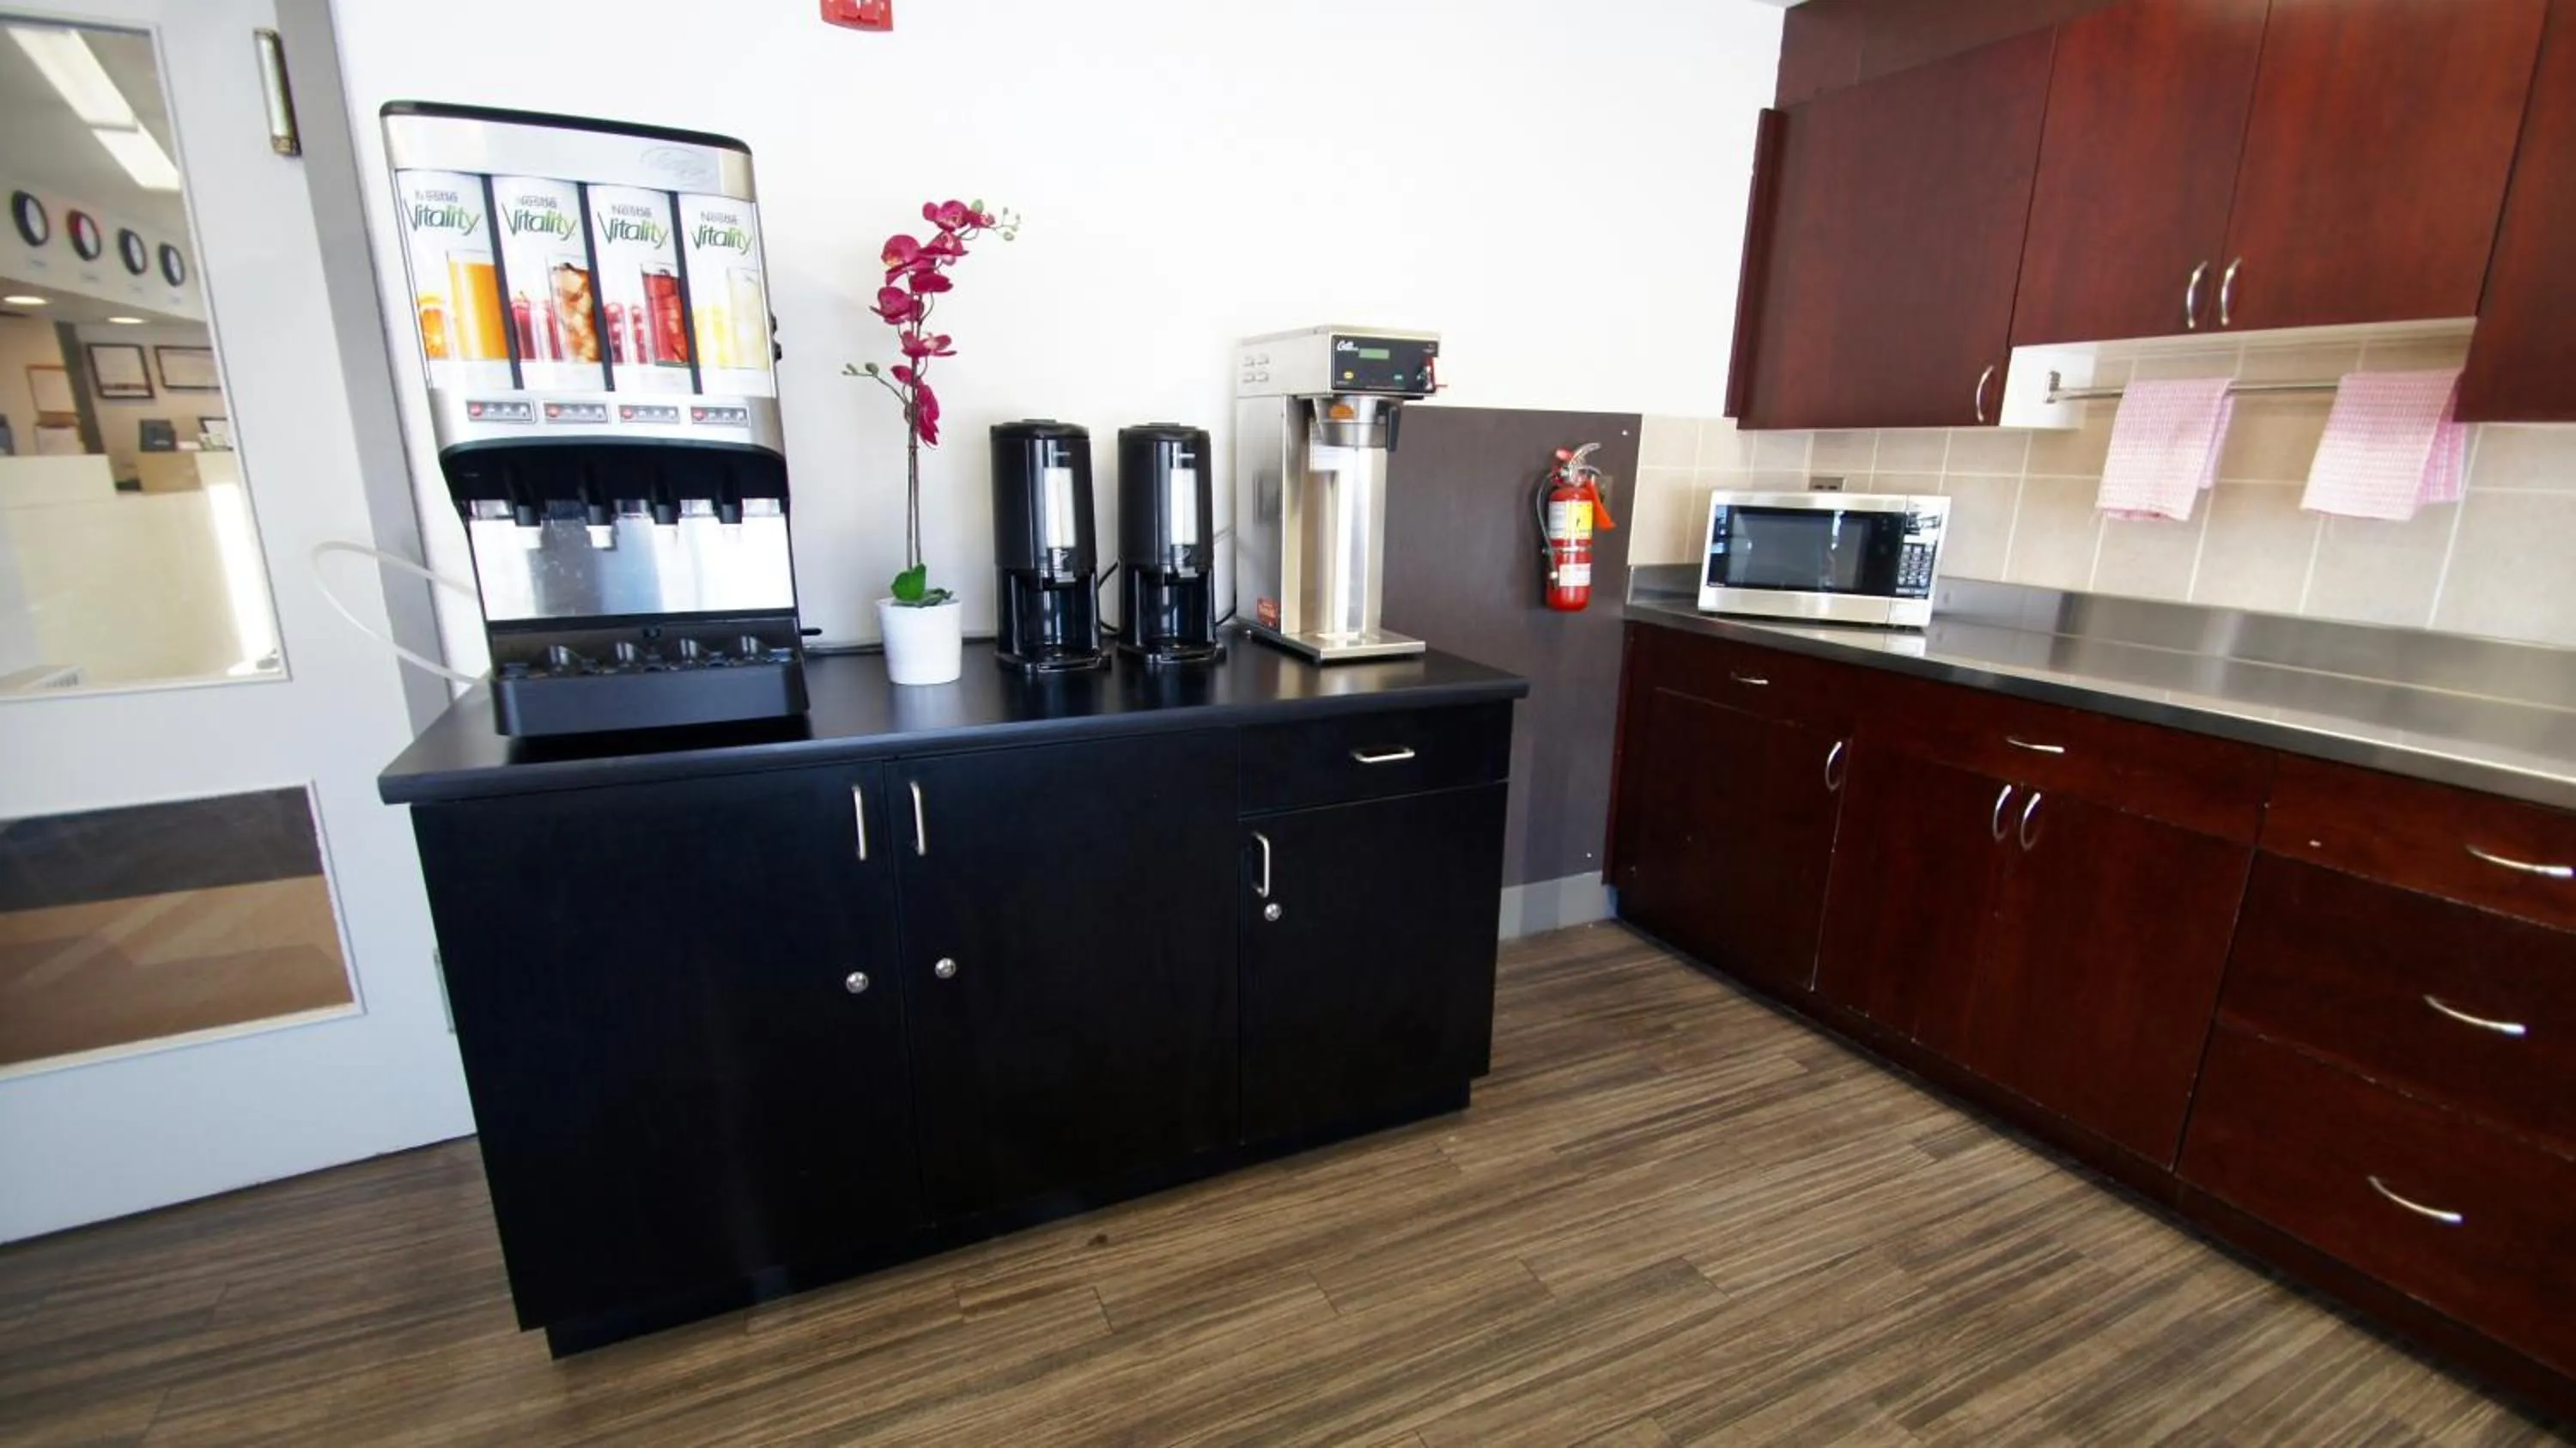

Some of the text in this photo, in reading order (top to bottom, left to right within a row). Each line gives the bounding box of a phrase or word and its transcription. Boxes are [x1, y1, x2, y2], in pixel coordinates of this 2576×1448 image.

[404, 198, 481, 236] Vitality
[501, 202, 578, 241] Vitality
[597, 210, 669, 250] Vitality
[690, 221, 753, 255] Vitality
